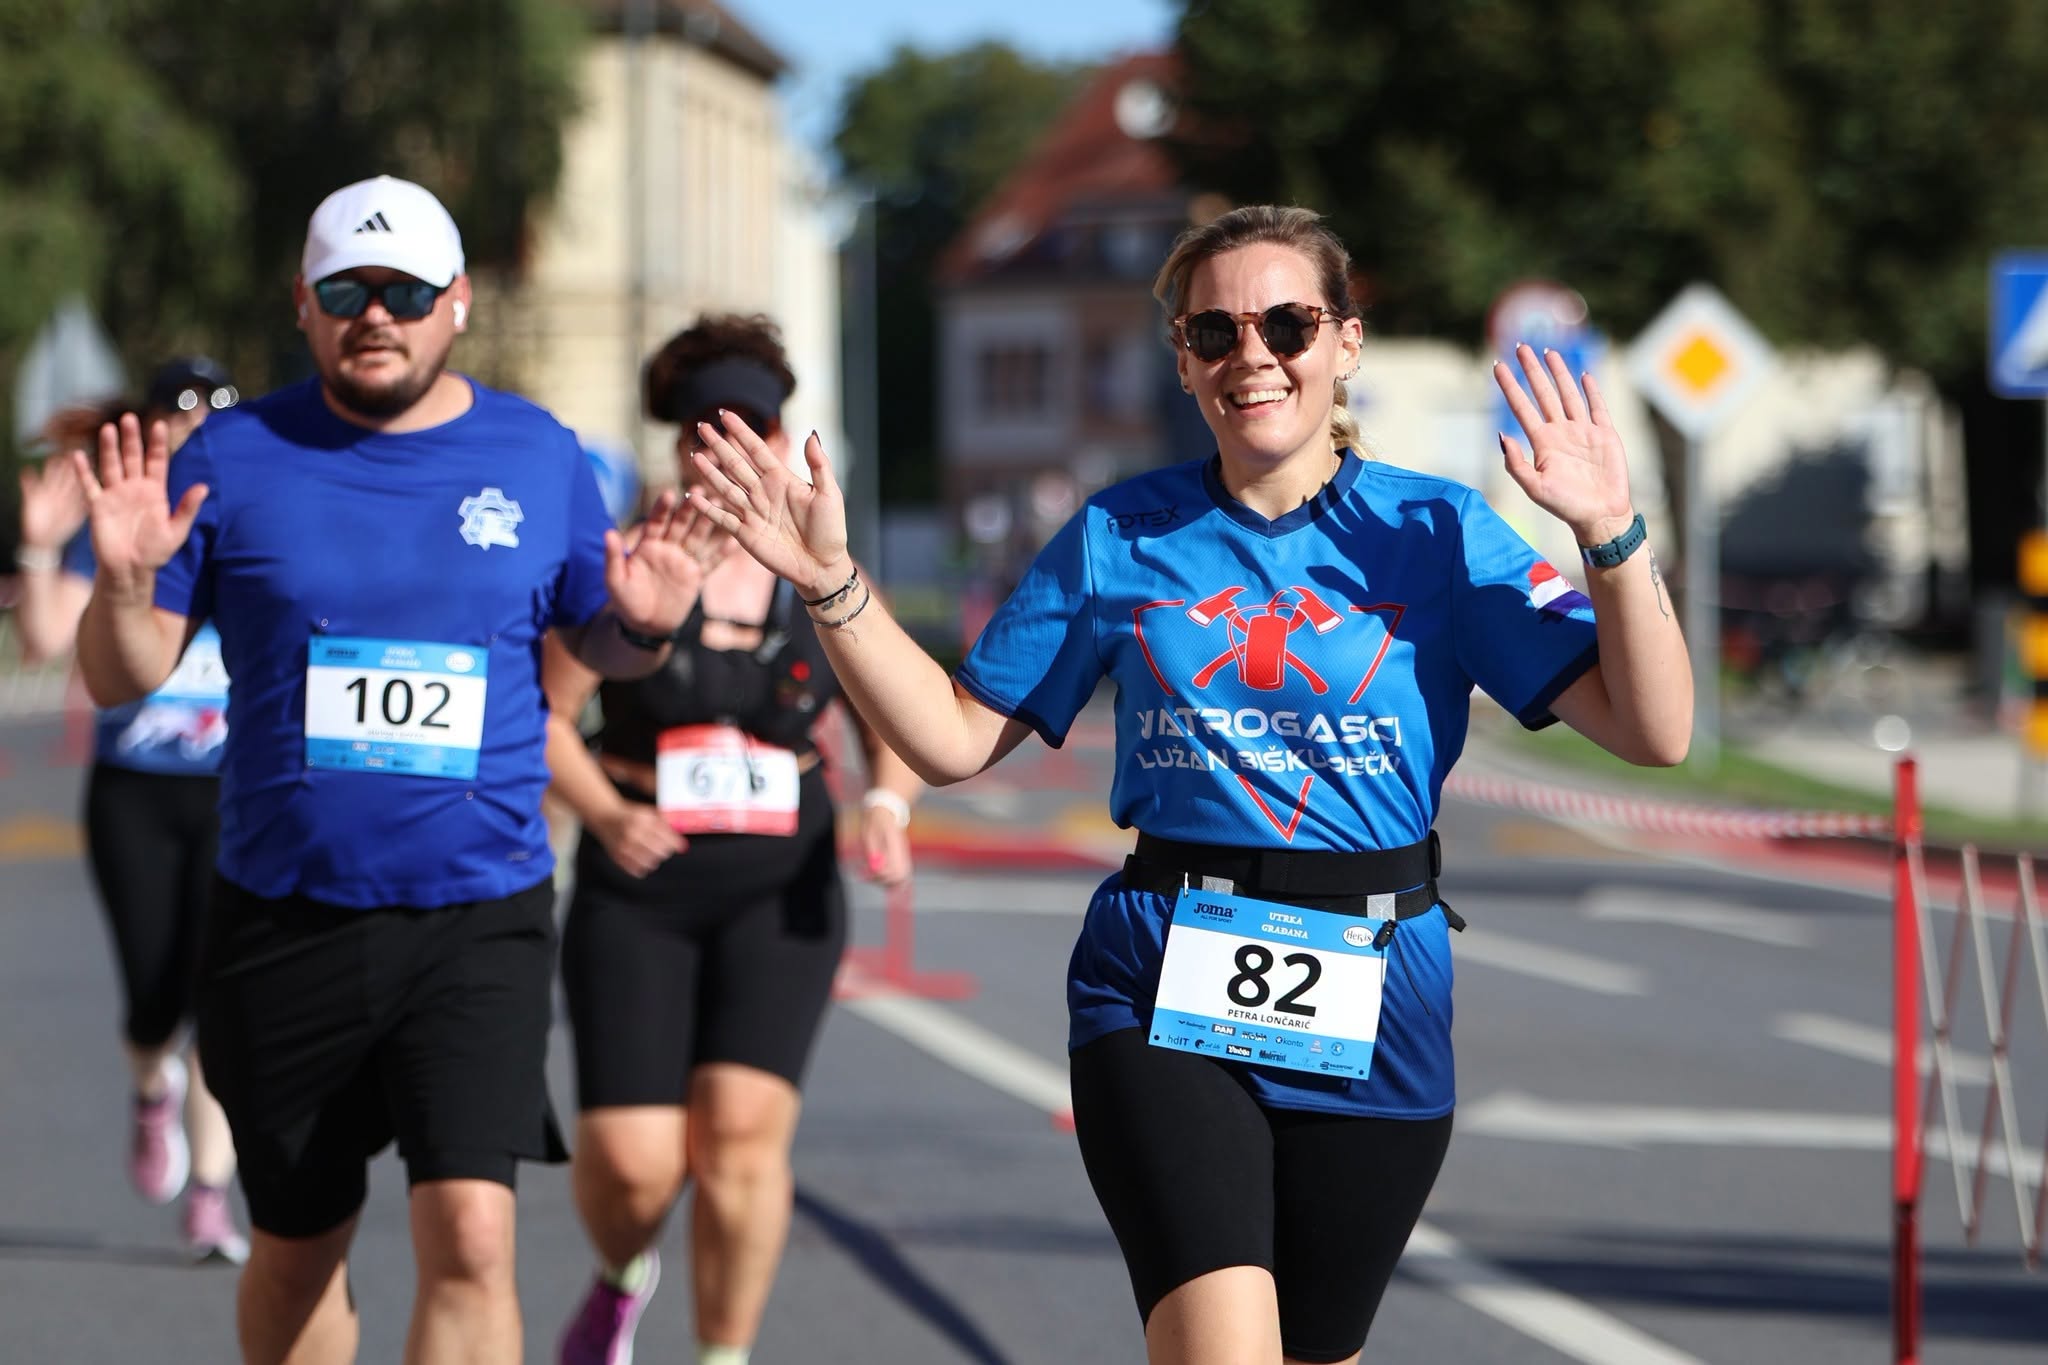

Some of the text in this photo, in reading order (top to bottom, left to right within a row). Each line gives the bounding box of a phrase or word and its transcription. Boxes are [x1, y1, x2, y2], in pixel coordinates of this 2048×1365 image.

[346, 677, 451, 728] 102
[1136, 707, 1402, 748] VATROGASCI
[1136, 744, 1229, 771] LUŽAN
[1269, 911, 1303, 926] UTRKA
[1226, 944, 1322, 1018] 82
[1214, 1025, 1234, 1036] PAN
[1227, 1008, 1312, 1031] PETRA LONČARIĆ
[1167, 1034, 1190, 1047] hdIT
[1283, 1039, 1304, 1049] konto
